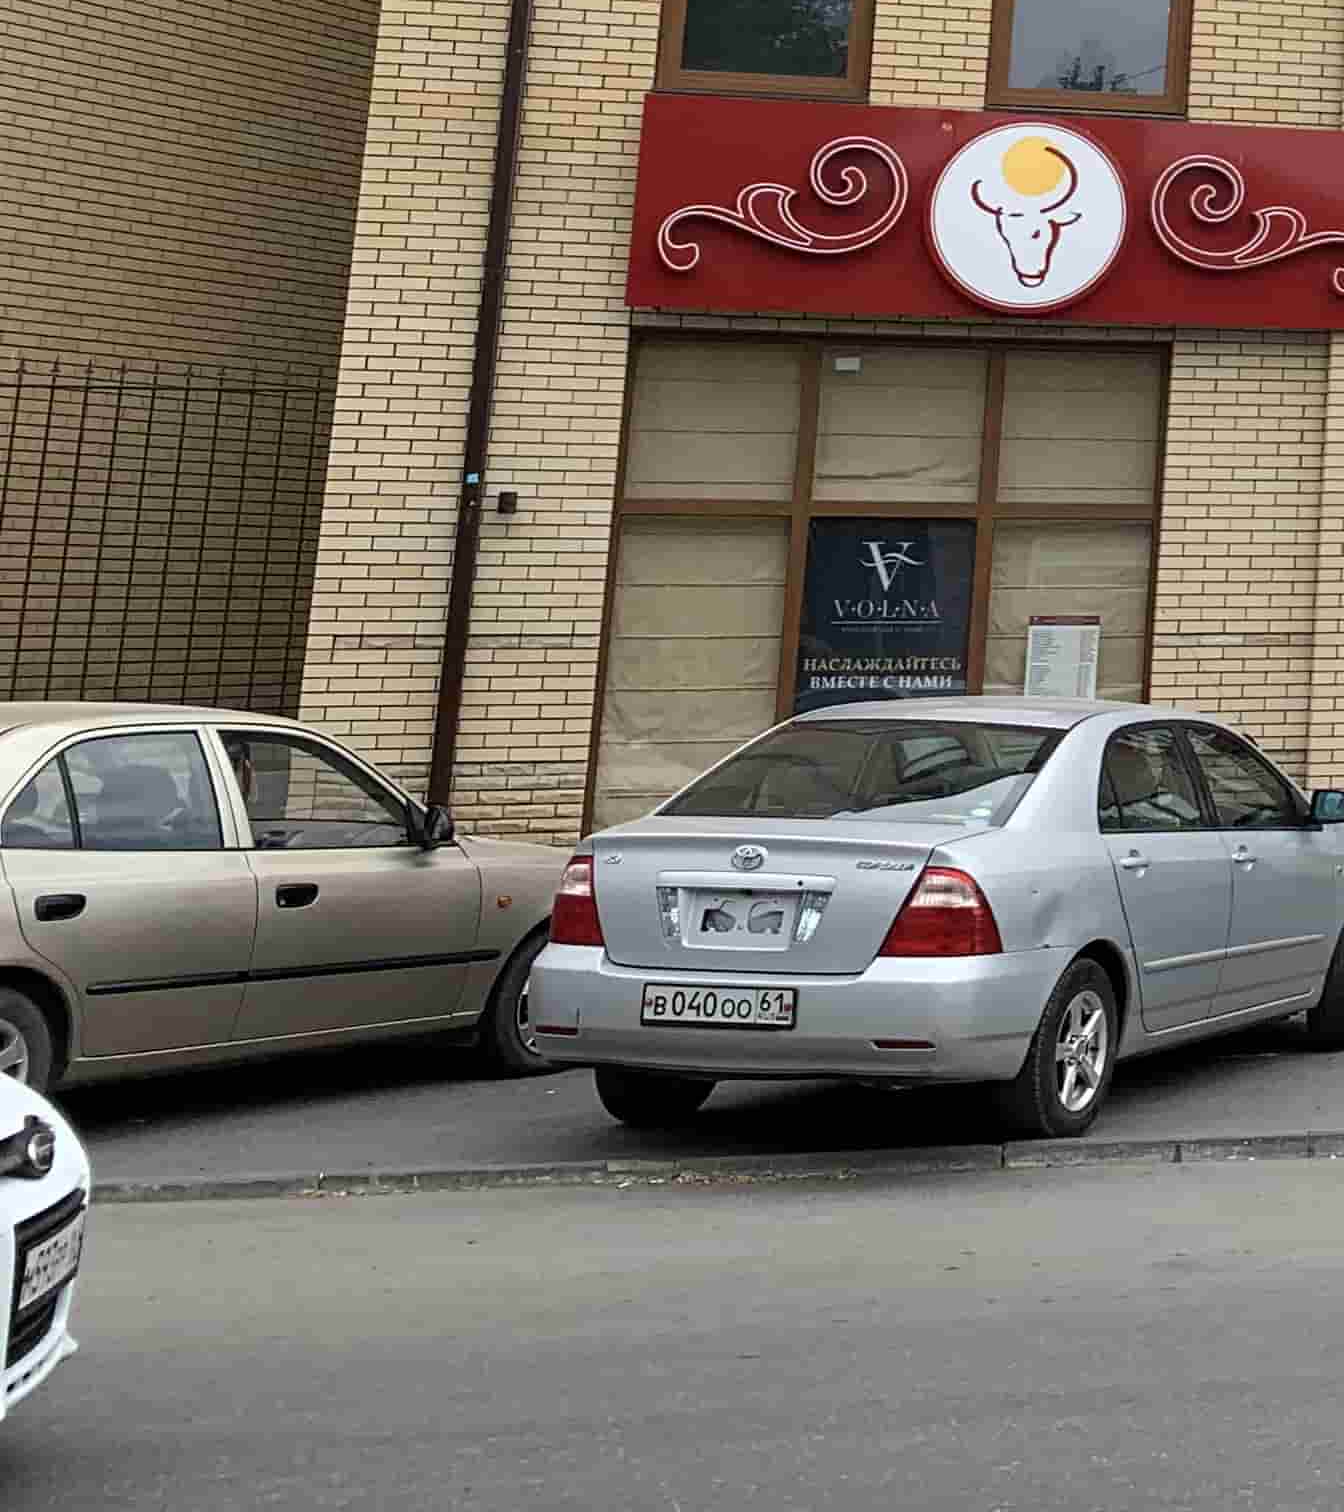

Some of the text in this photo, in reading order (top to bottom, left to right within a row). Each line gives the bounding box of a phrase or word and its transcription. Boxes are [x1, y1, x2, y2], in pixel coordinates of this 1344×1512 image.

[801, 655, 962, 672] НАСЛАЖДАЙТЕСЬ
[809, 675, 879, 689] ВМЕСТЕ
[898, 675, 953, 689] НАМИ
